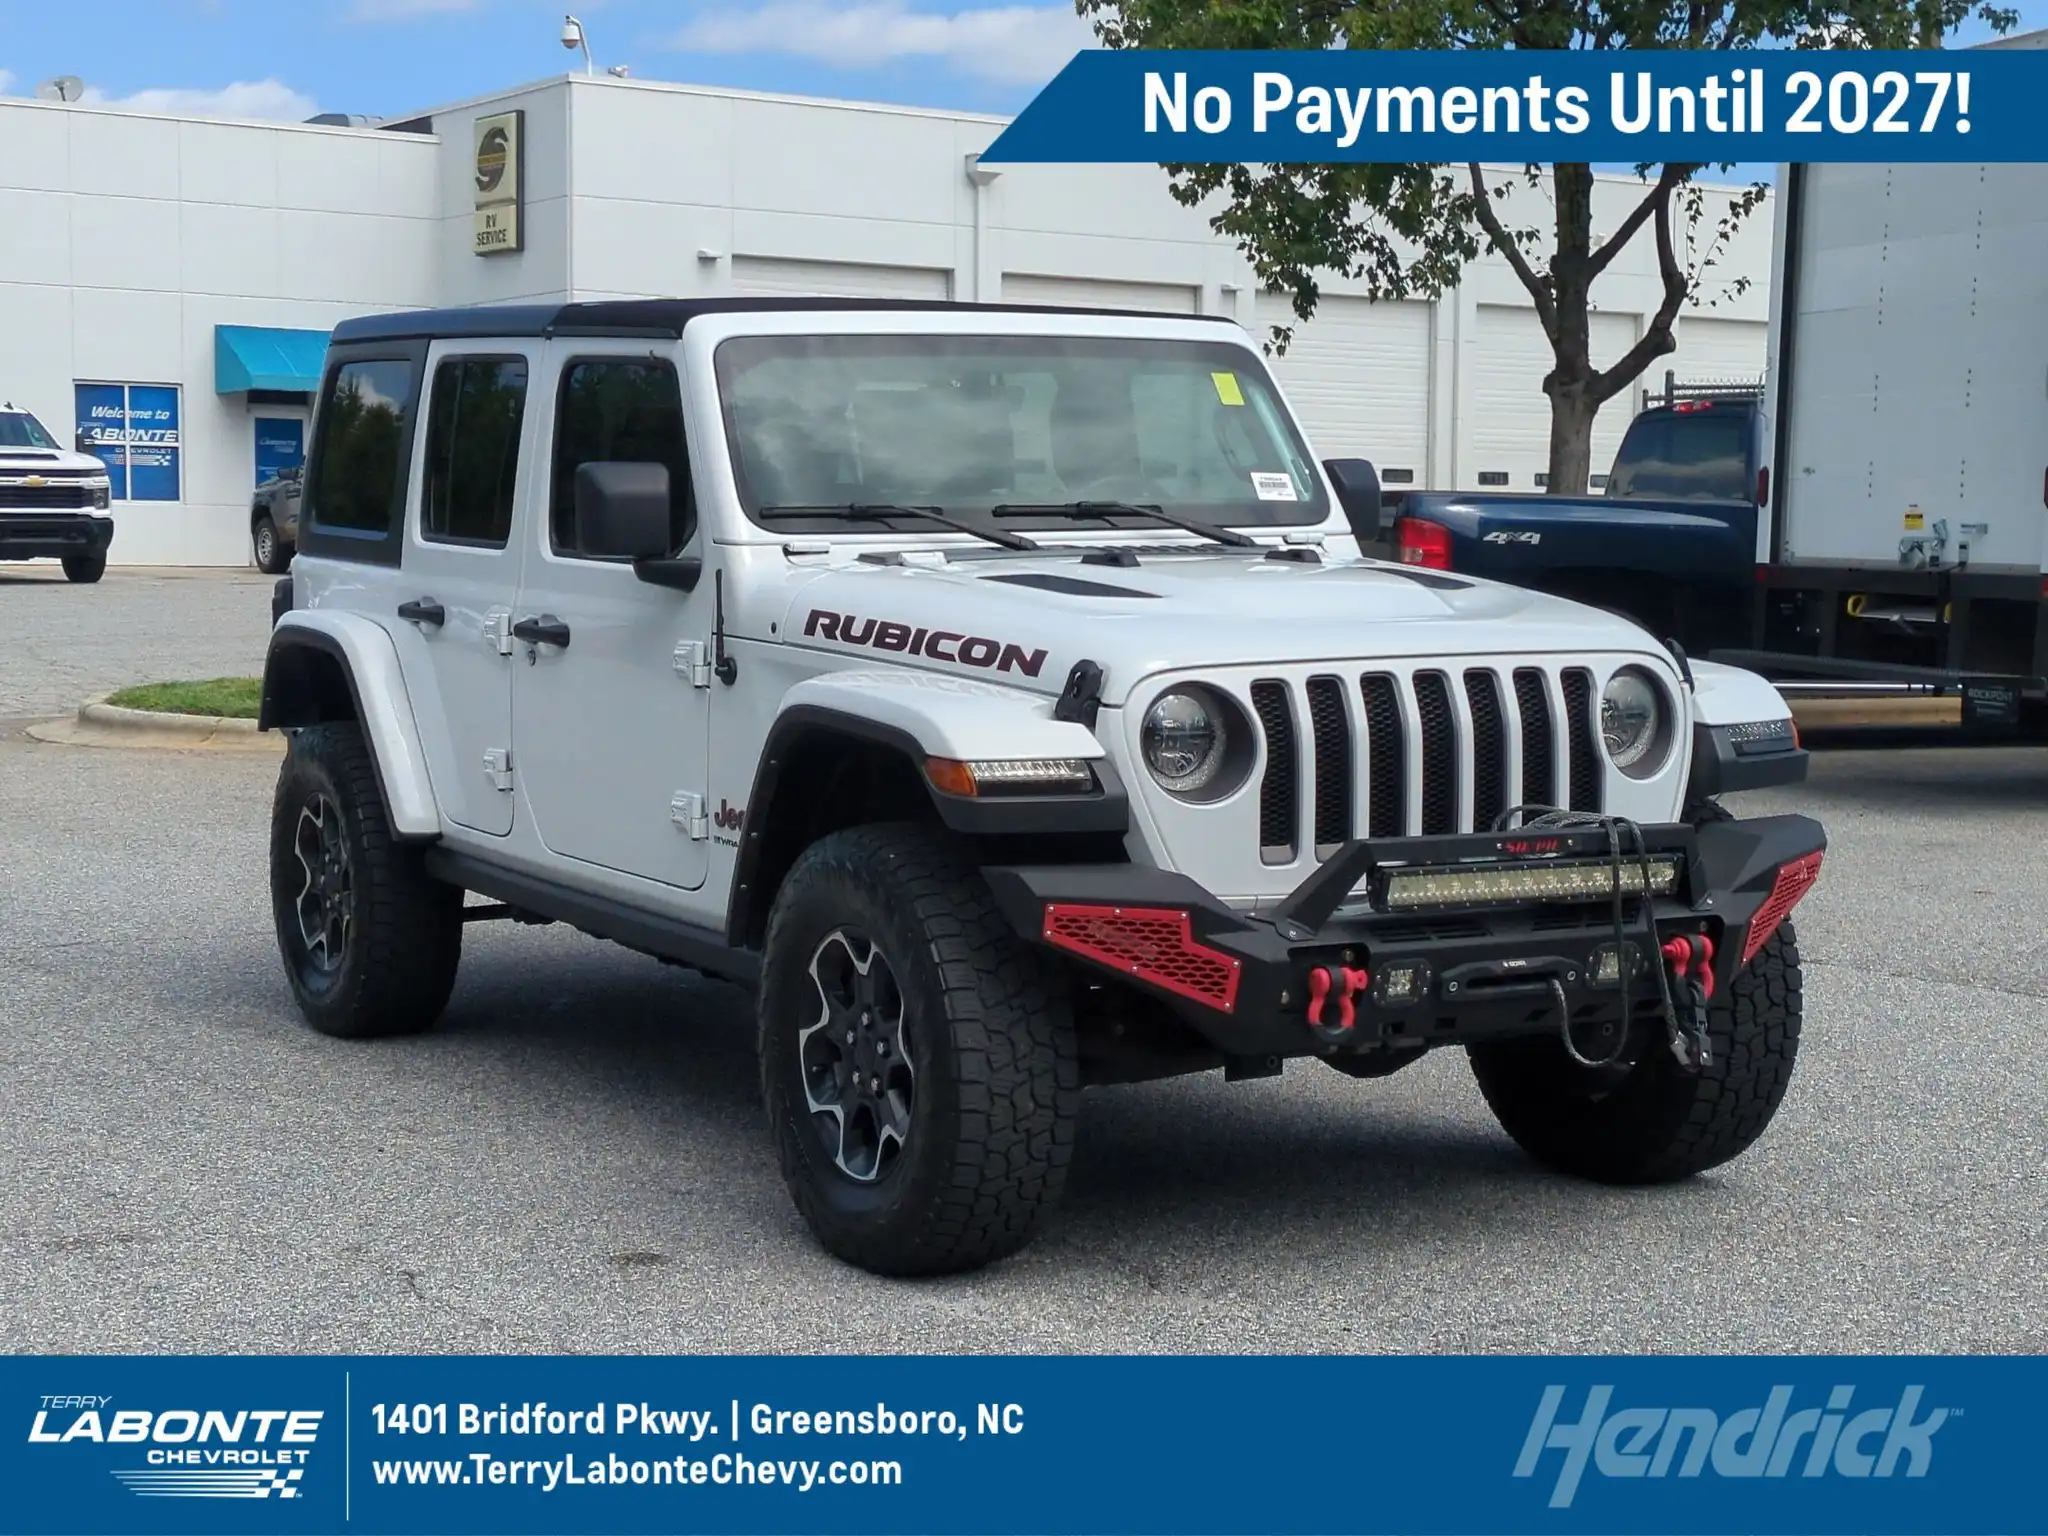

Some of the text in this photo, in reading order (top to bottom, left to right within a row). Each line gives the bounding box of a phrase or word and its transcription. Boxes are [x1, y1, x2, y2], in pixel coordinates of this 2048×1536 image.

[485, 214, 498, 228] RV
[476, 228, 507, 246] SERVICE
[154, 409, 170, 420] to
[804, 609, 1049, 677] RUBICON
